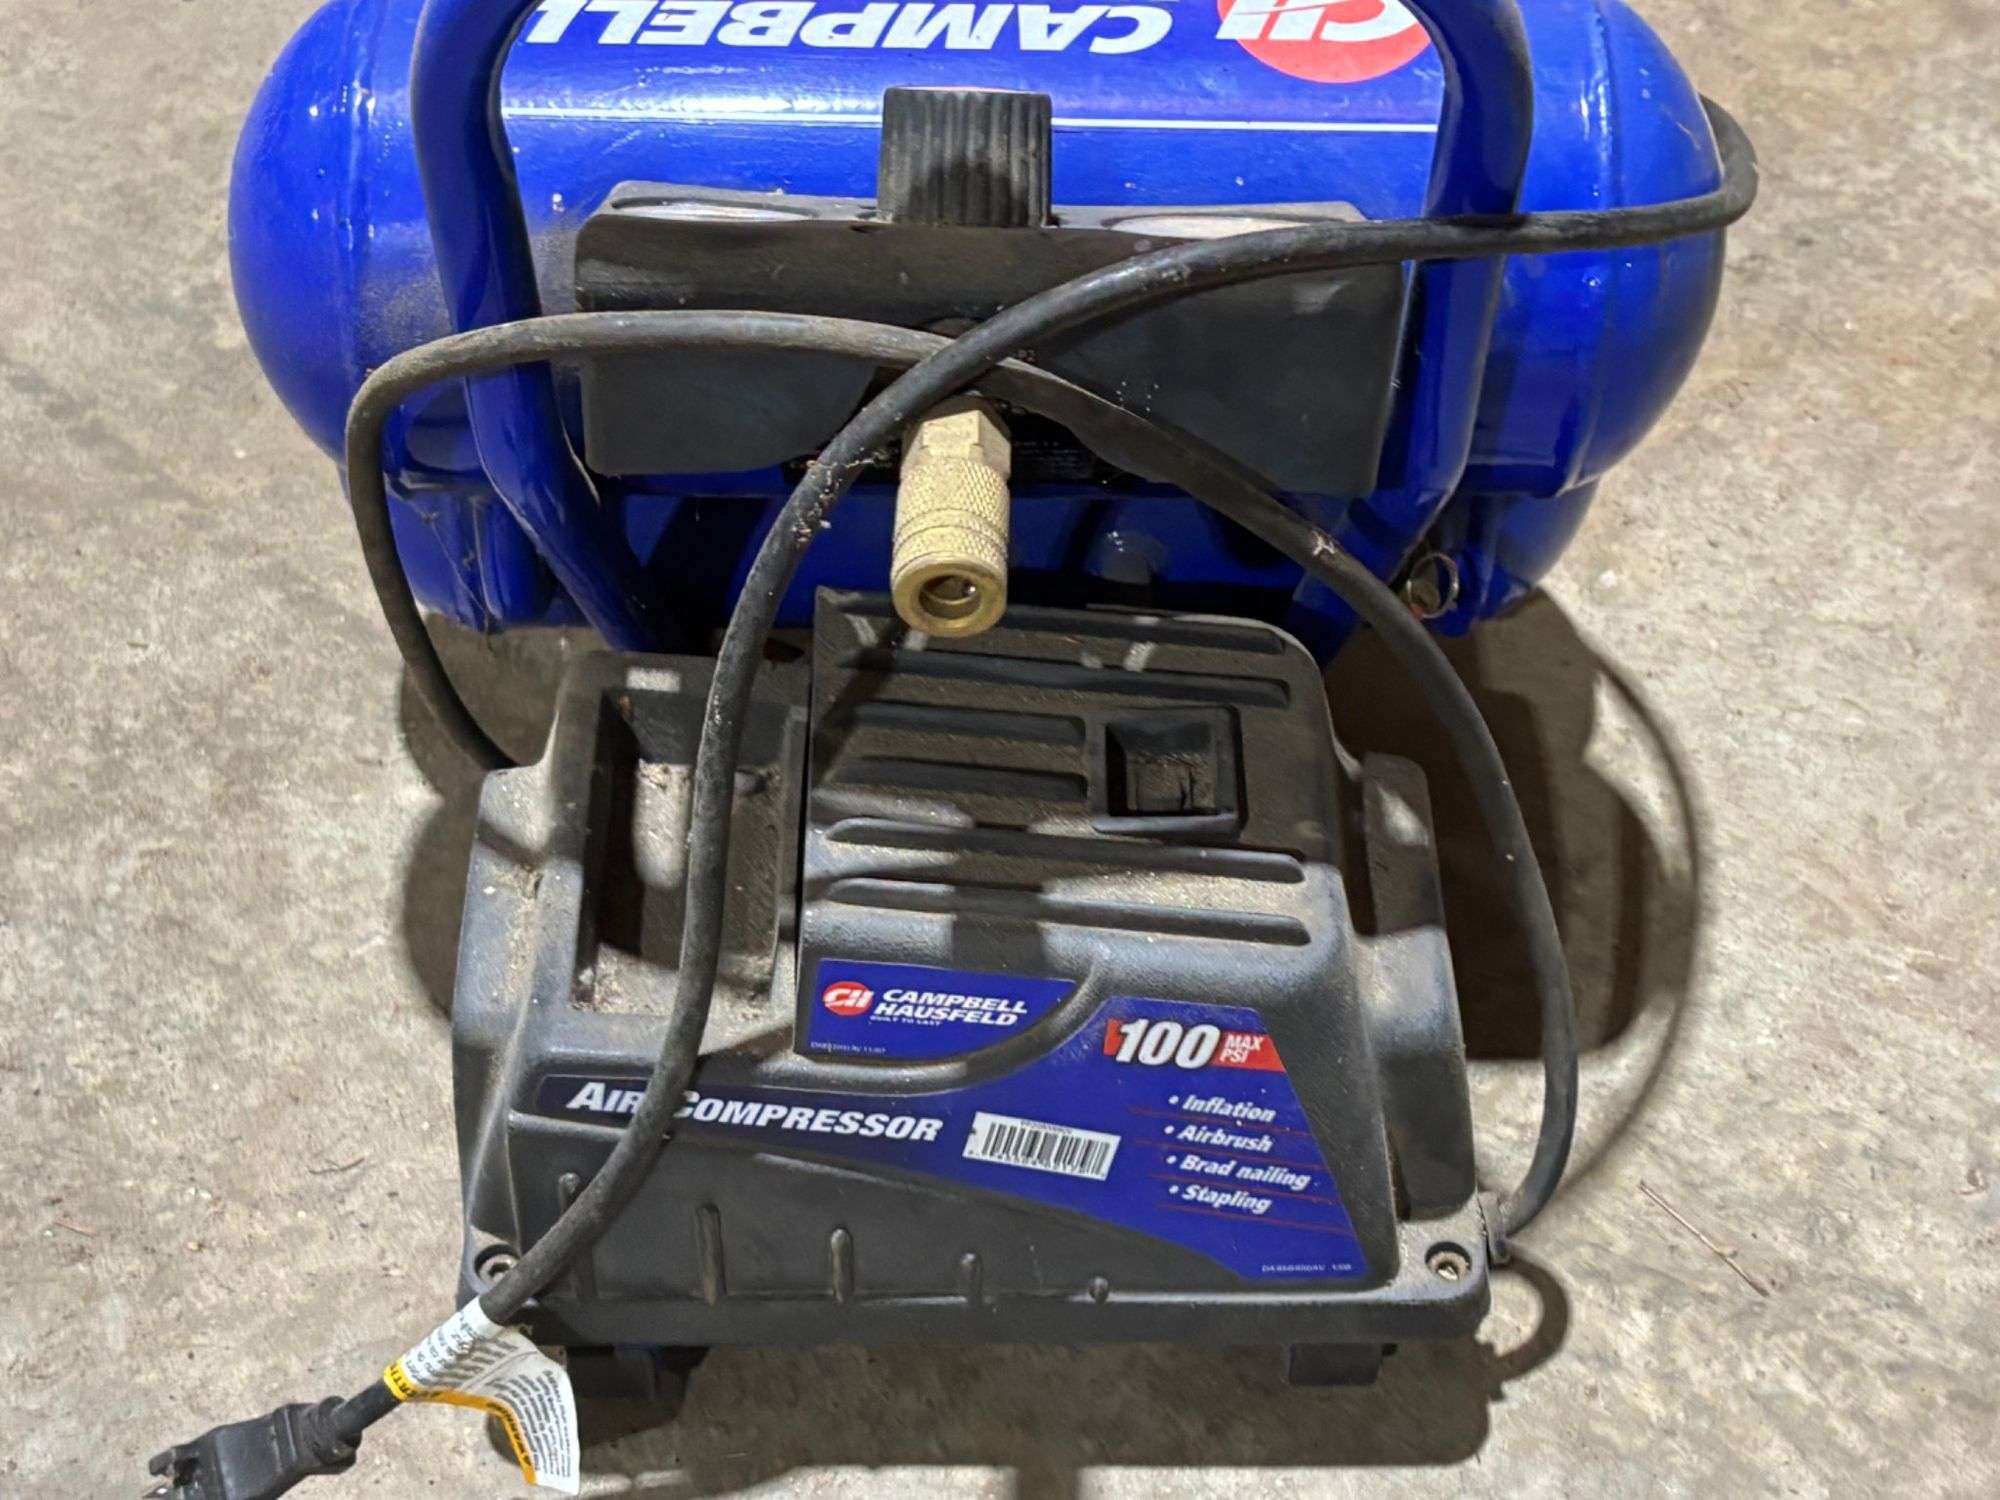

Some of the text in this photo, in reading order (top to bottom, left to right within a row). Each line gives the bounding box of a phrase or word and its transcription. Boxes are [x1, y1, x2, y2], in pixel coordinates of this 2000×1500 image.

[524, 0, 1172, 53] CAMPBELL
[874, 1002, 1018, 1027] HAUSFELD
[883, 989, 1028, 1014] CAMPBELL
[1116, 1018, 1220, 1069] 100
[1219, 1047, 1249, 1064] PSI
[1224, 1034, 1264, 1051] MAX
[566, 1082, 648, 1114] AIR
[1182, 1094, 1276, 1123] Inflation
[1176, 1125, 1273, 1153] Airbrush
[1180, 1154, 1311, 1191] Brad nailing
[1181, 1184, 1272, 1215] Stapling
